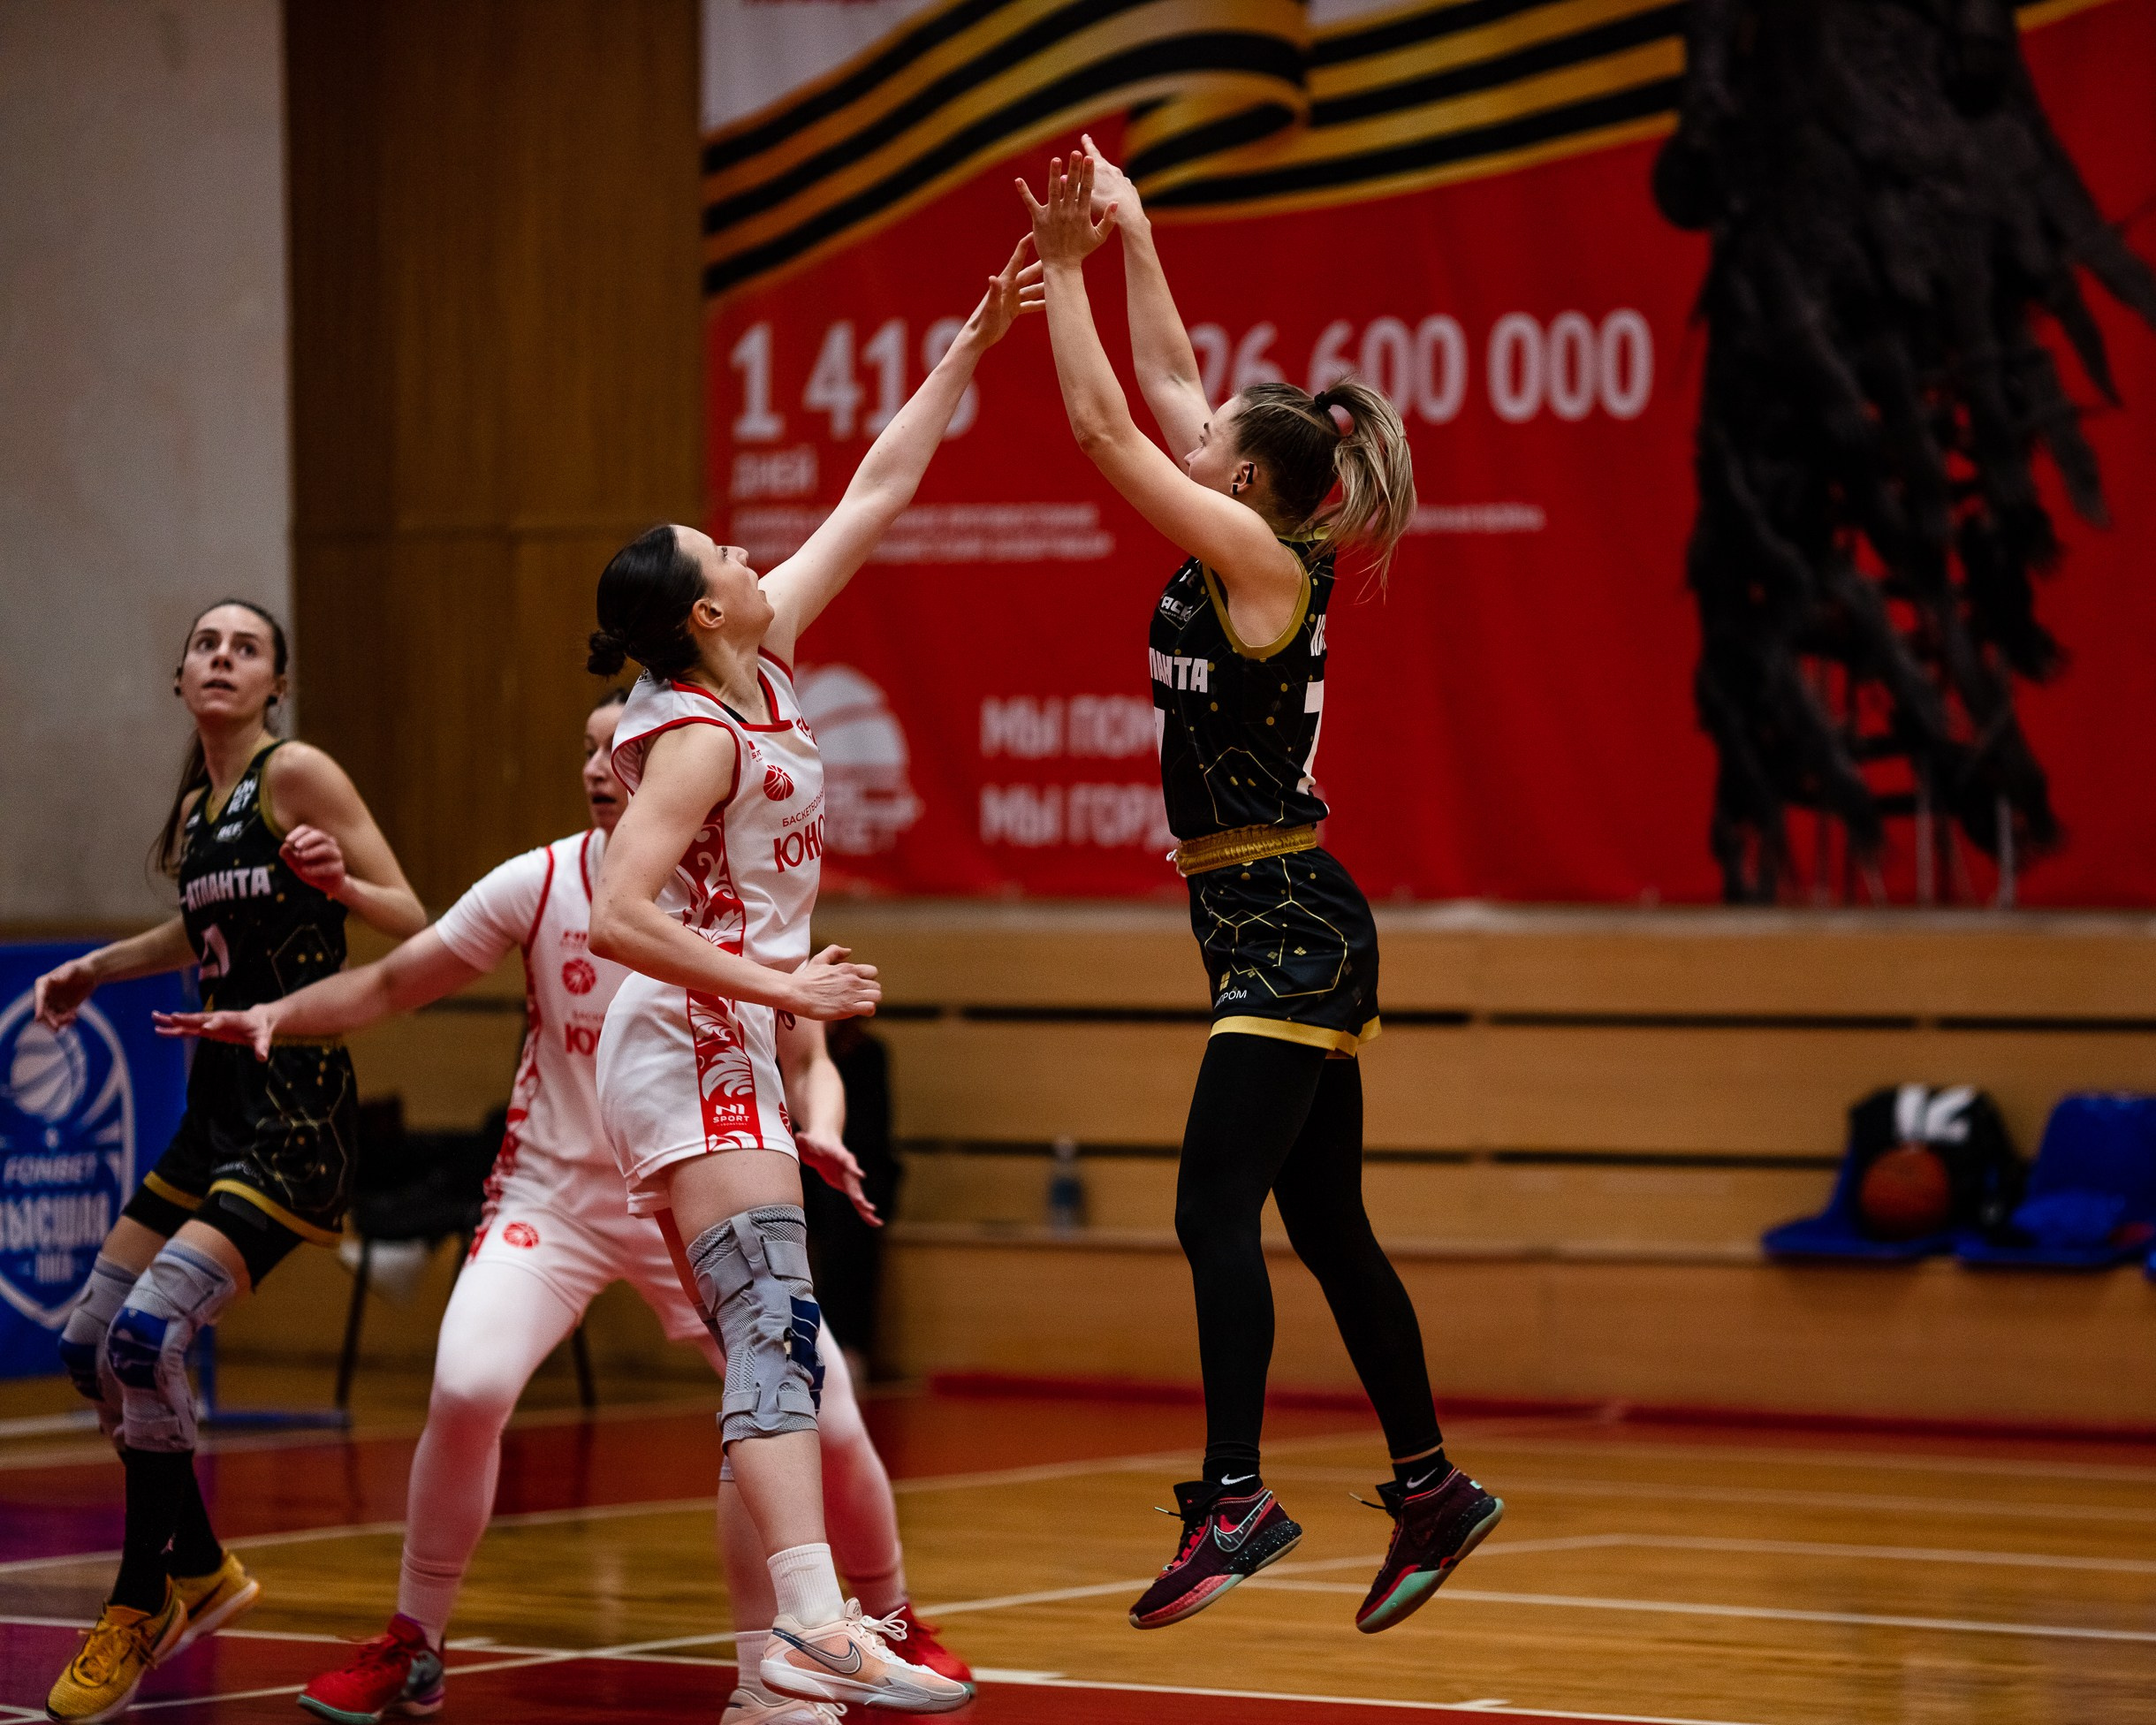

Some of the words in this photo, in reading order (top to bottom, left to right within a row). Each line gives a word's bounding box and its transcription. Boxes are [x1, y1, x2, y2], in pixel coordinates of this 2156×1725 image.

[730, 320, 785, 441] 1
[1486, 308, 1655, 424] 000
[980, 694, 1063, 759] МЫ
[980, 782, 1063, 848] МЫ
